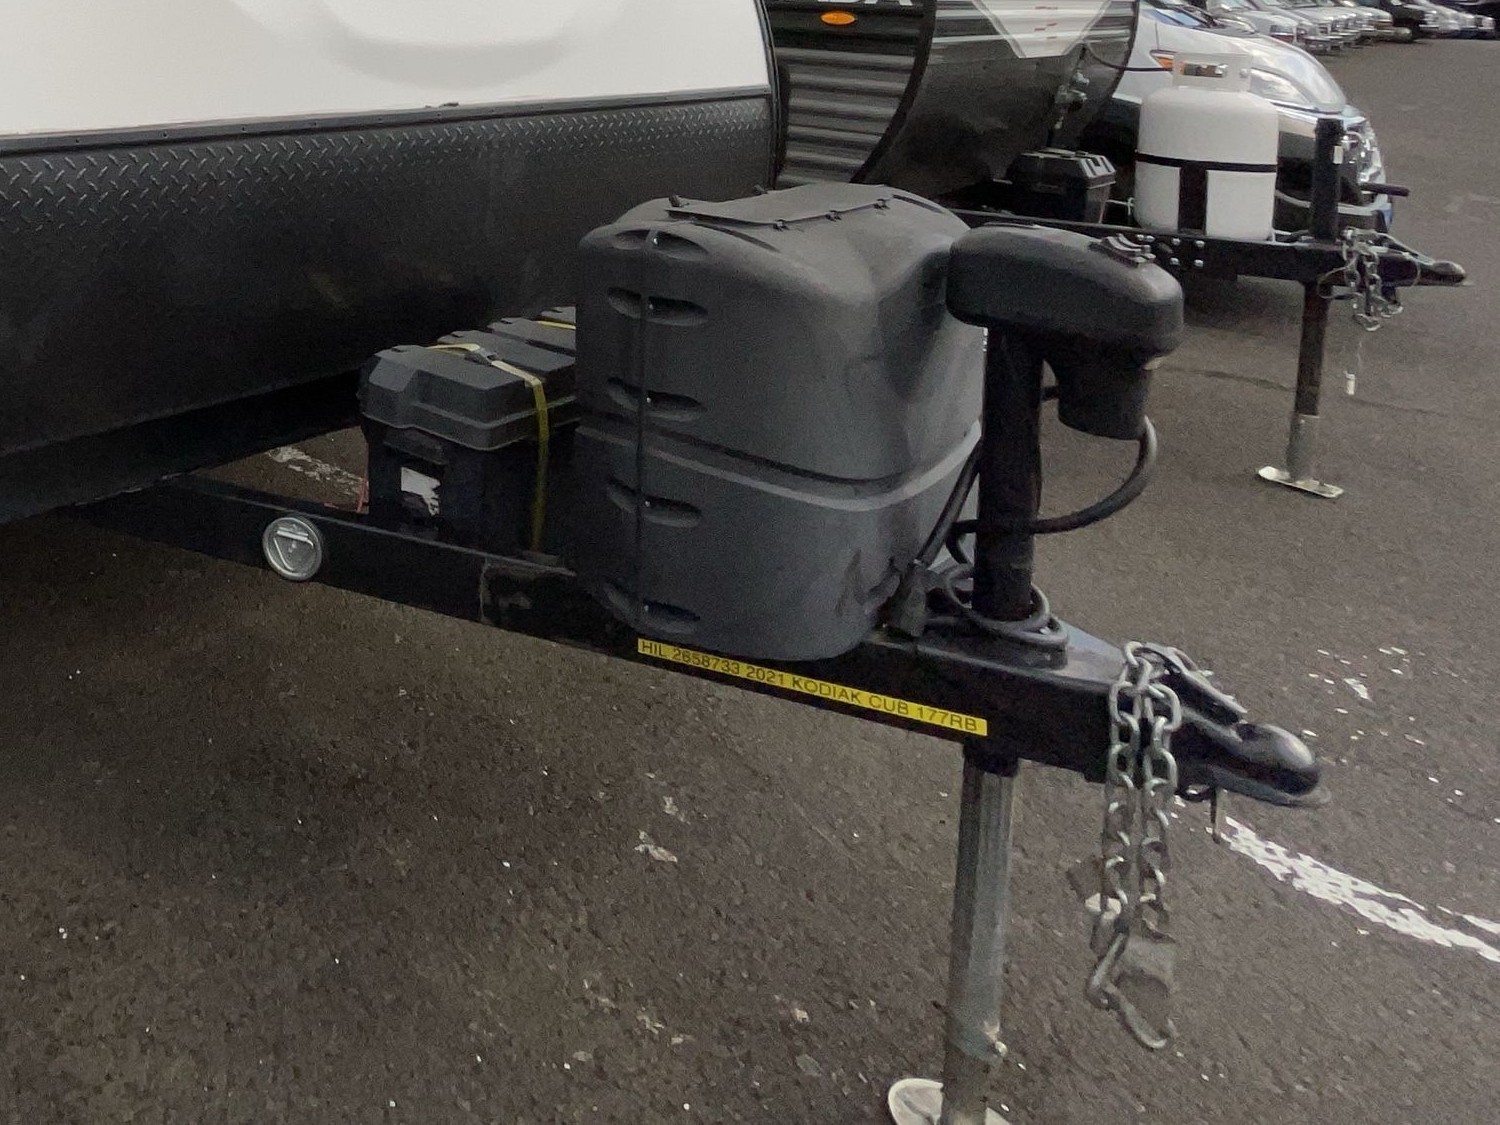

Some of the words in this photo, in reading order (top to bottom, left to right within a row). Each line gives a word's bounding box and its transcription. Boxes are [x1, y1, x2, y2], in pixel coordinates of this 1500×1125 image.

[641, 640, 667, 658] HIL
[672, 647, 740, 676] 2658733
[745, 665, 785, 686] 2021
[792, 676, 861, 704] KODIAK
[868, 694, 909, 715] CUB
[917, 706, 978, 732] 177RB
